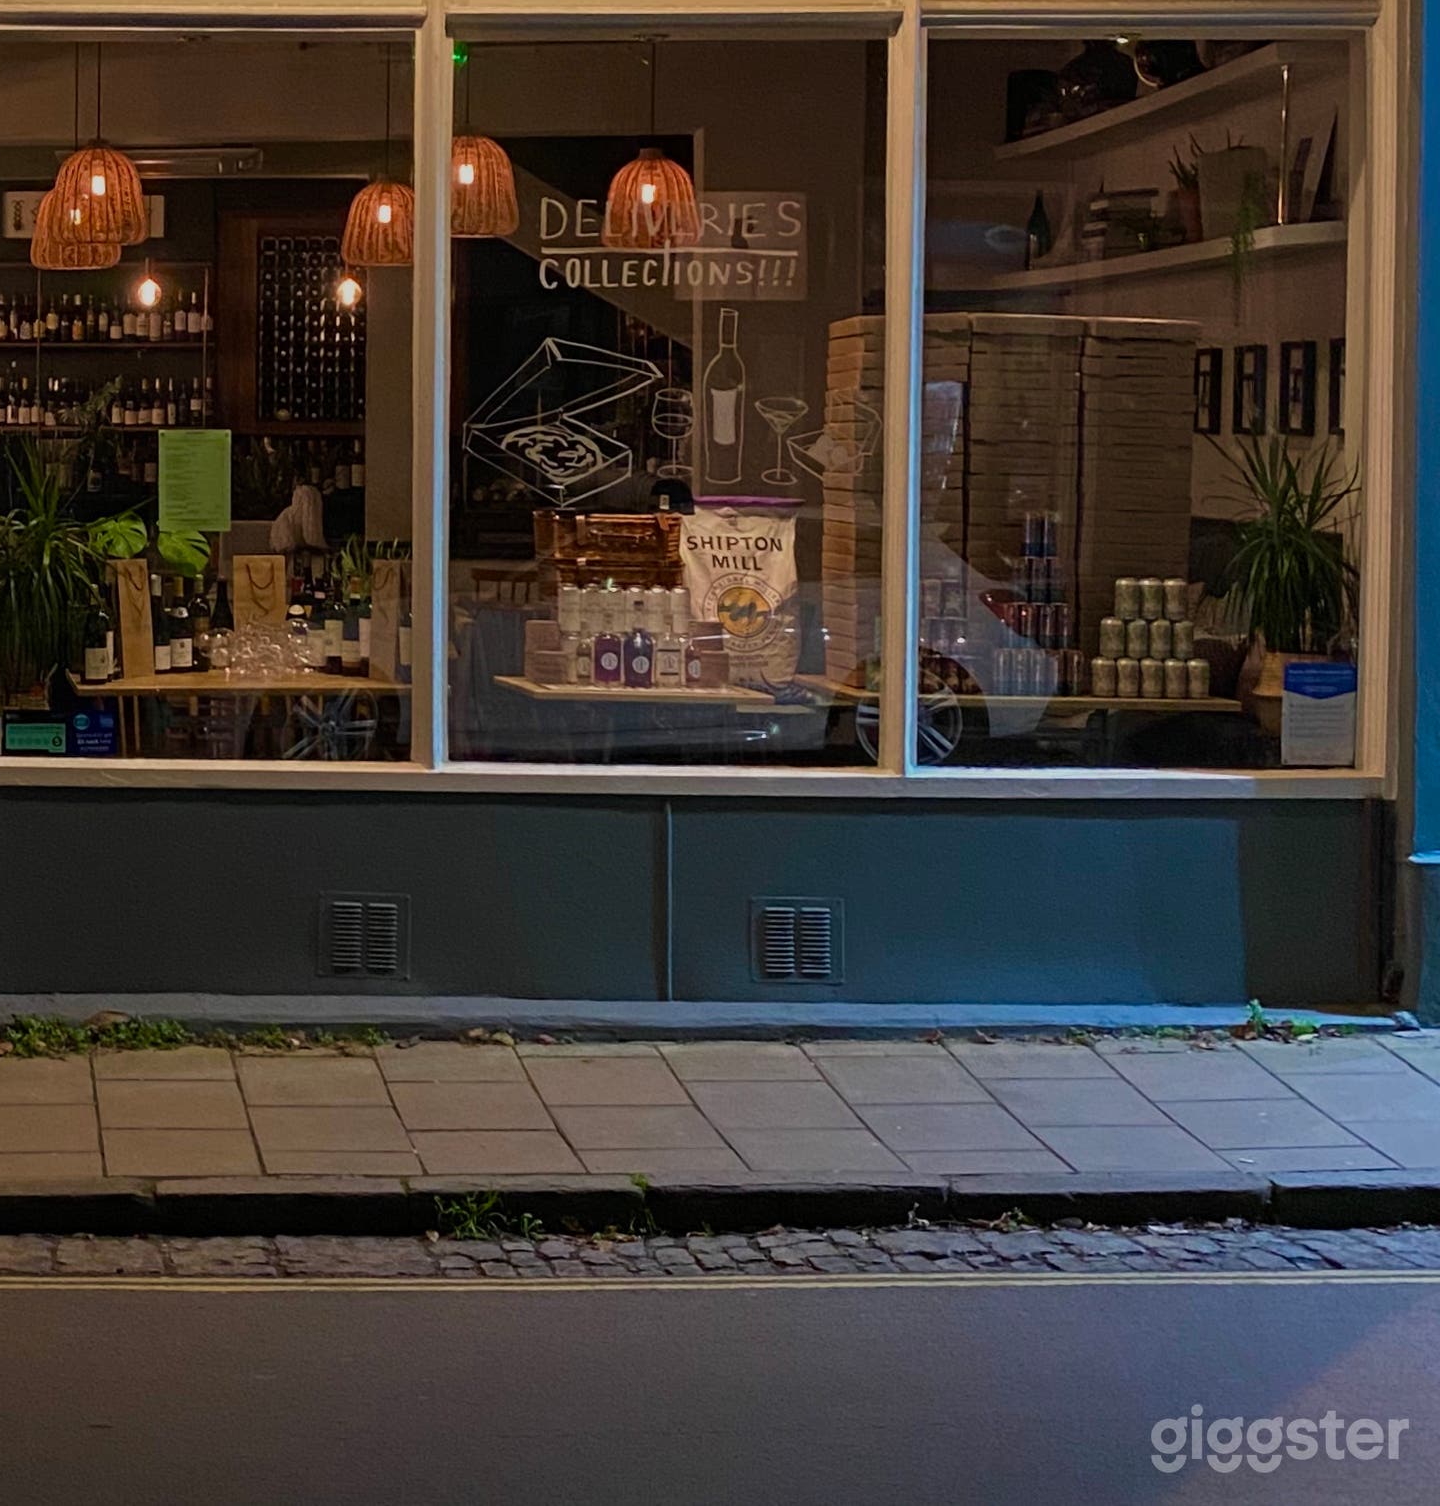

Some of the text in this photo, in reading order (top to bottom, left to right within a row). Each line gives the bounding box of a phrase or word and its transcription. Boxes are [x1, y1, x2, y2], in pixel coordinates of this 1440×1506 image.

[539, 196, 802, 241] DELIVERIES
[539, 240, 797, 289] COLLECTIONS!!!
[686, 535, 784, 552] SHIPTON
[711, 554, 763, 572] MILL
